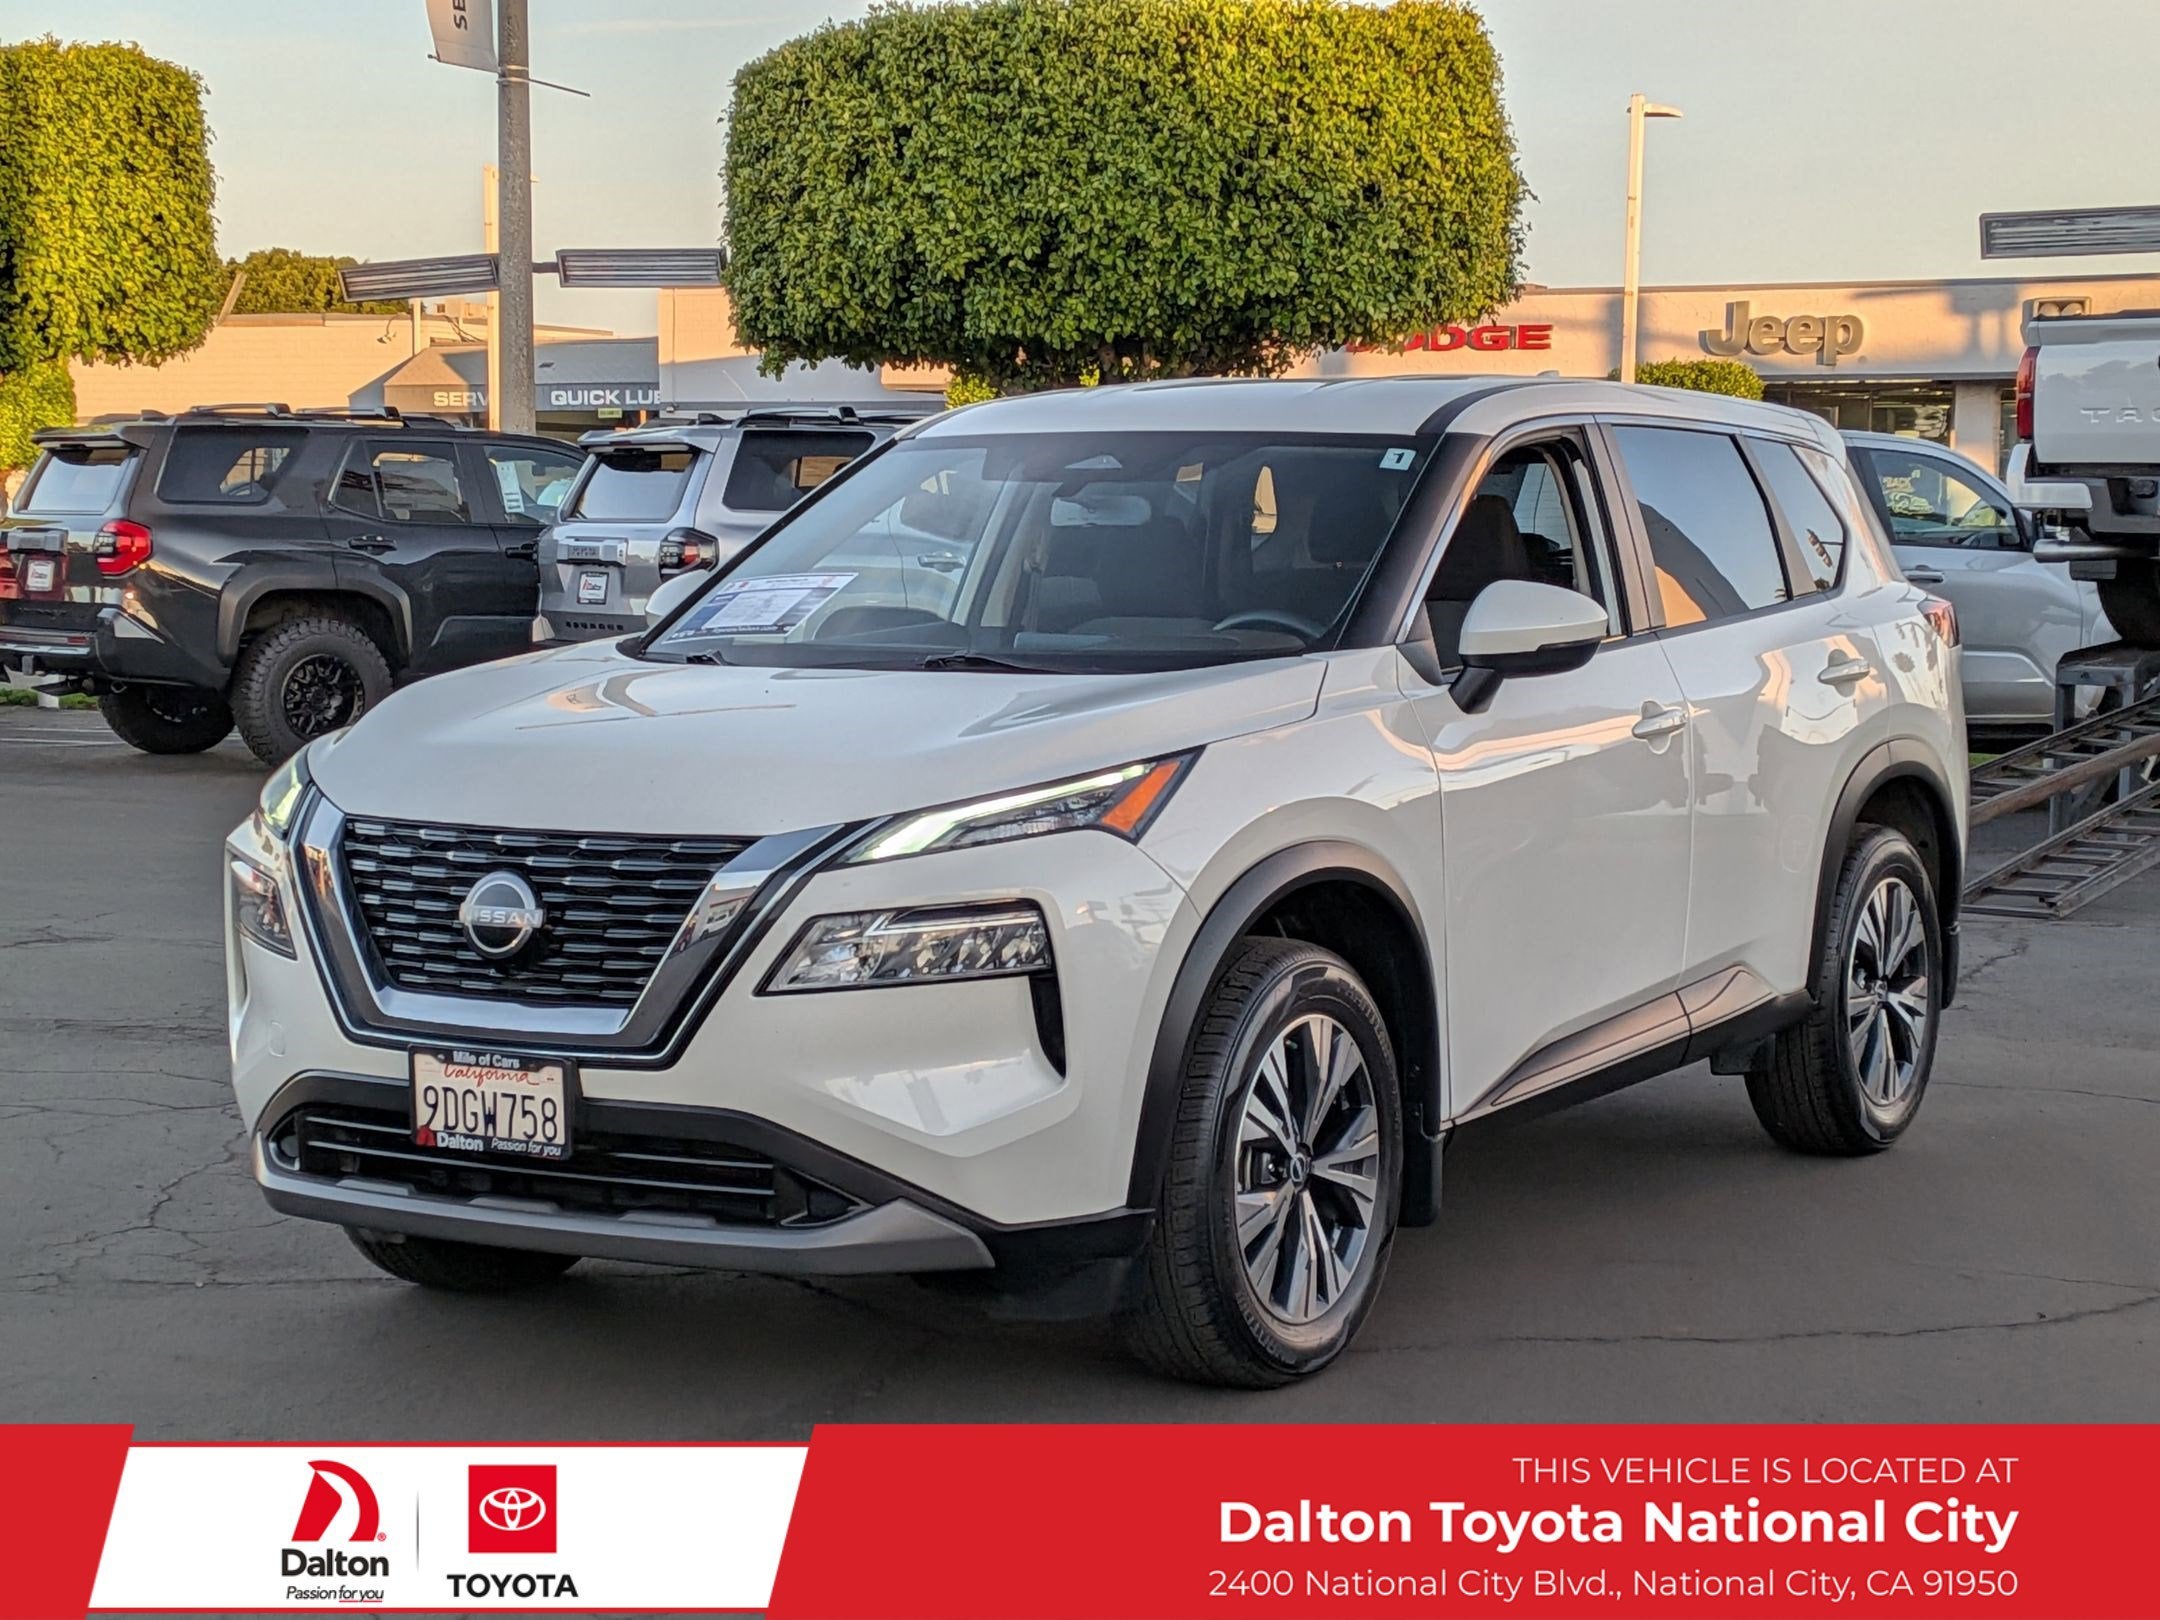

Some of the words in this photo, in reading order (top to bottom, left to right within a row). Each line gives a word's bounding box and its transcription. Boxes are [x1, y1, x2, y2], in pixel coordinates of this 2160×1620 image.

[1346, 323, 1553, 352] DGE
[1699, 300, 1864, 366] Jeep
[550, 390, 621, 406] QUICK
[1393, 451, 1405, 464] 1
[453, 1051, 476, 1065] Mile
[478, 1054, 490, 1066] of
[492, 1055, 520, 1069] Cars
[443, 1063, 540, 1087] California
[423, 1085, 558, 1142] 9DGW758
[436, 1132, 484, 1152] Dalton
[491, 1137, 527, 1152] Passion
[527, 1140, 542, 1154] for
[542, 1146, 562, 1157] you
